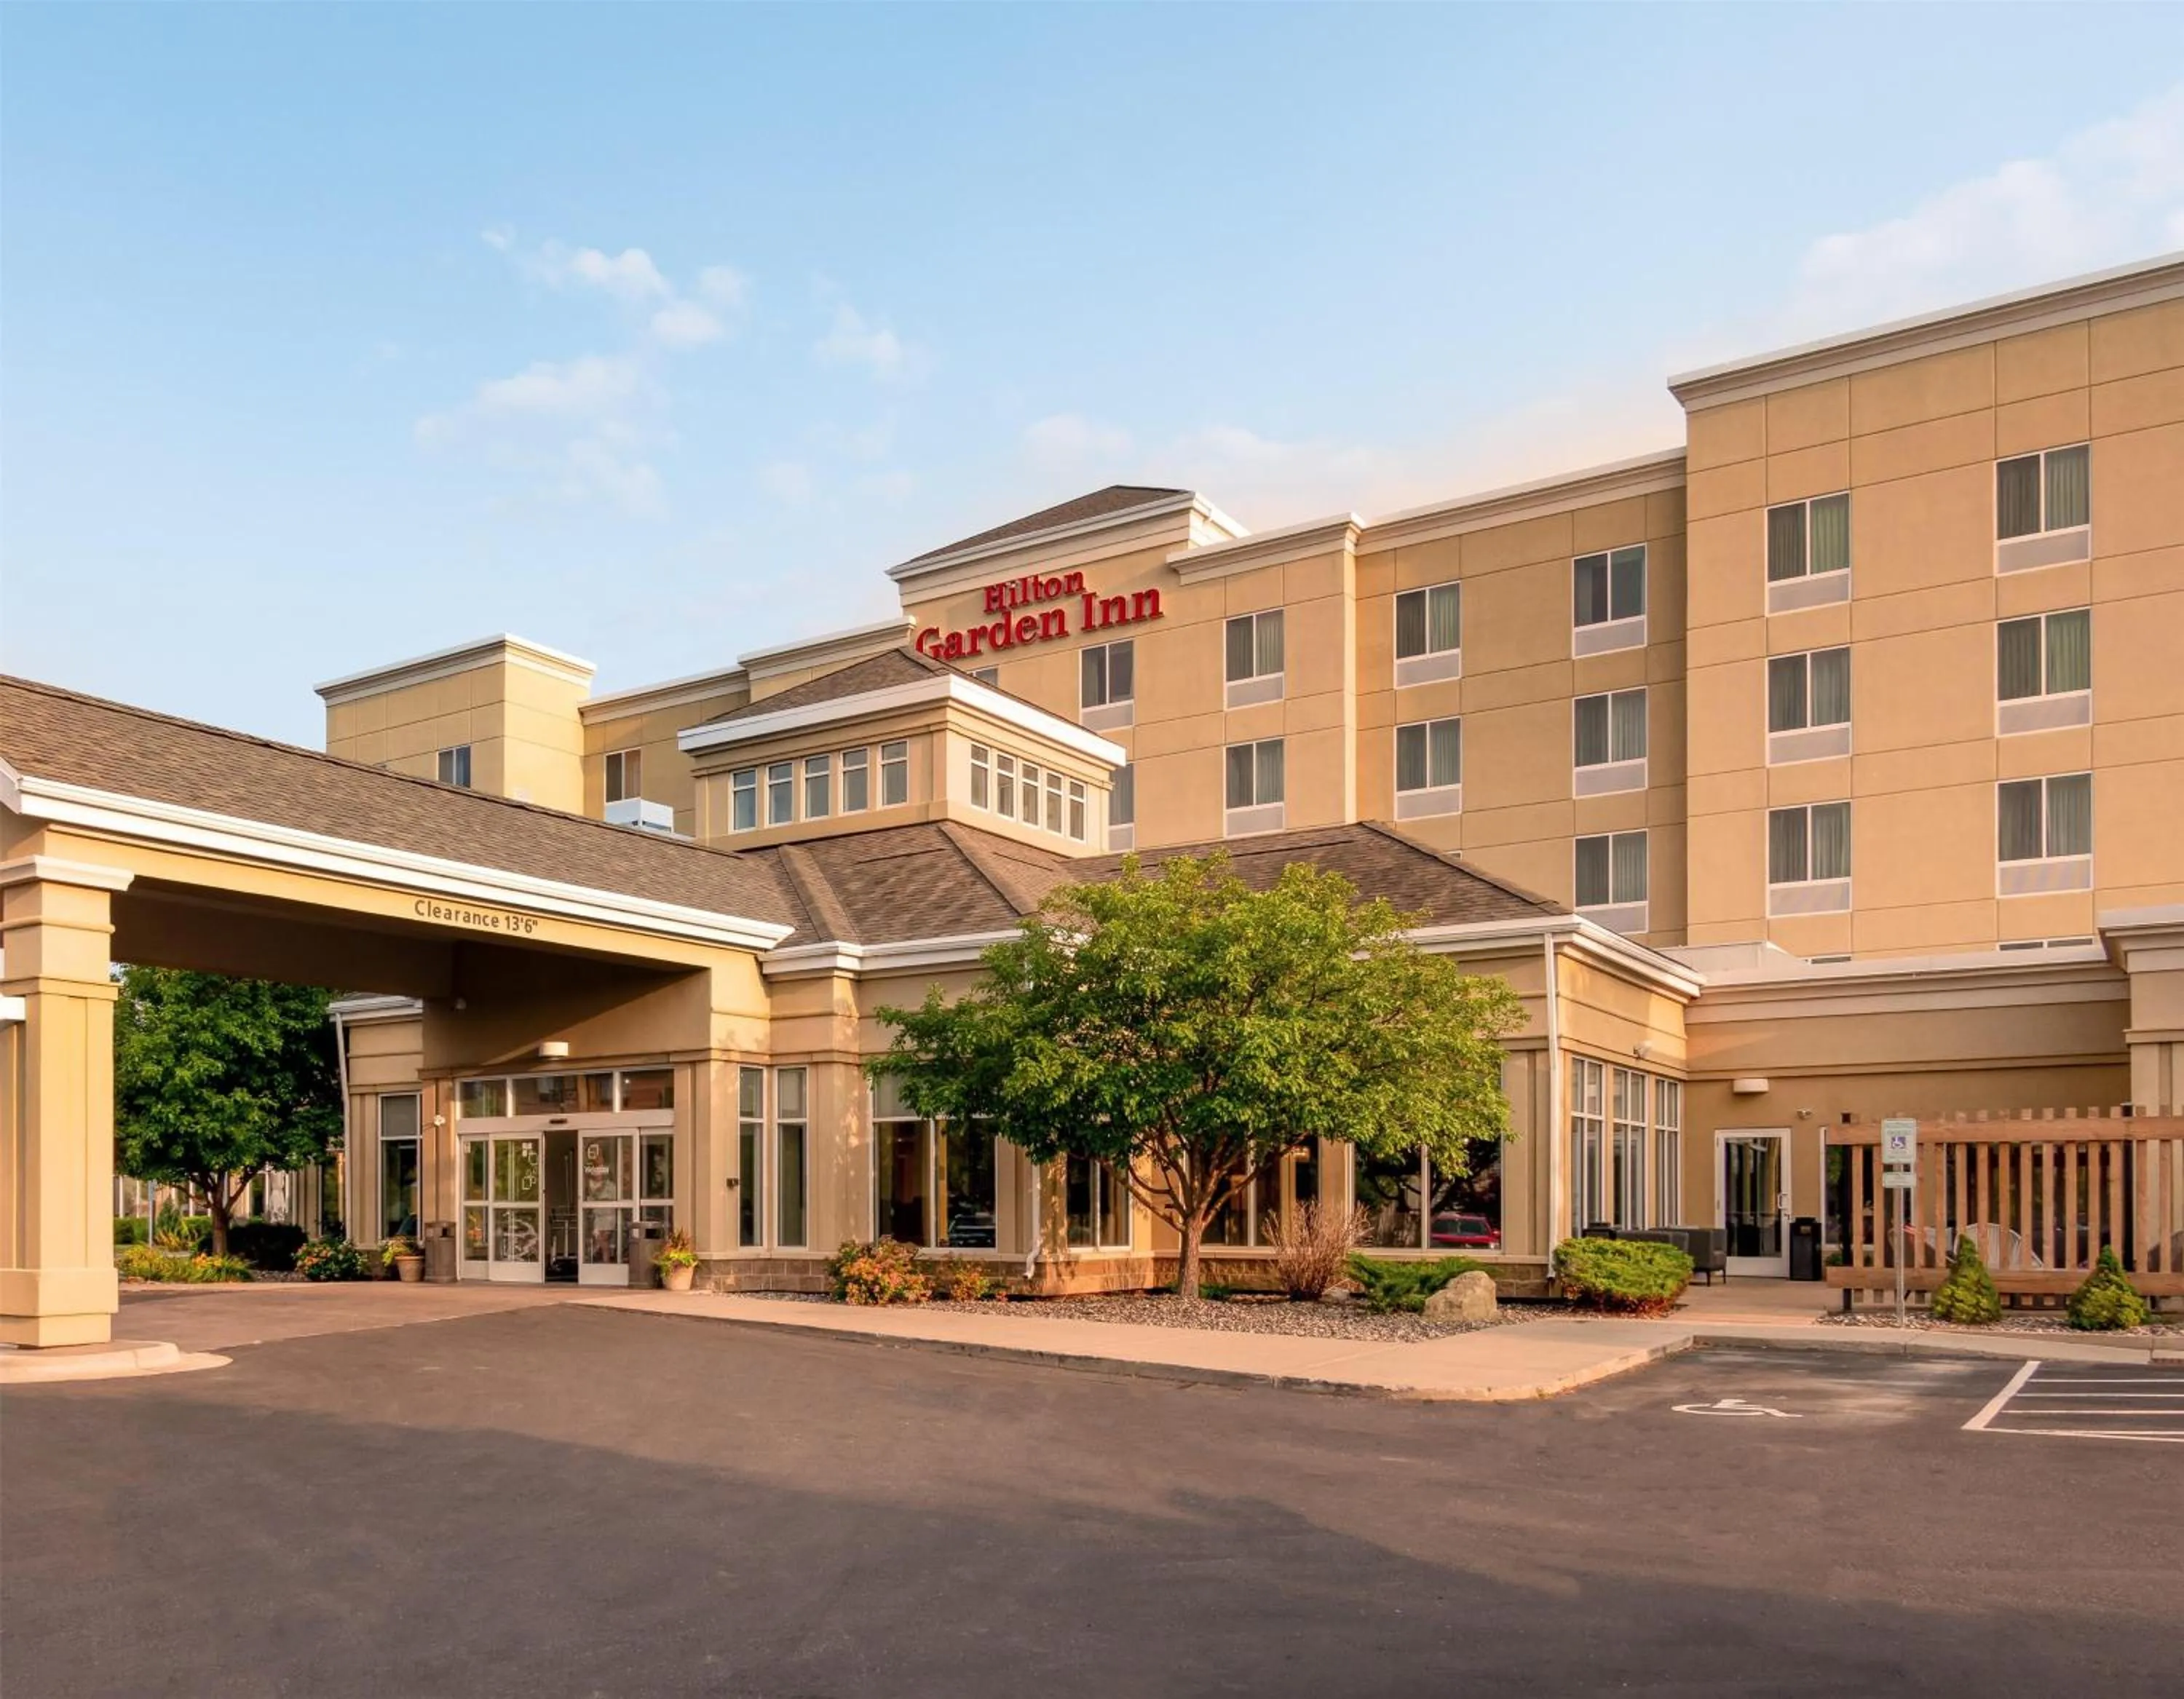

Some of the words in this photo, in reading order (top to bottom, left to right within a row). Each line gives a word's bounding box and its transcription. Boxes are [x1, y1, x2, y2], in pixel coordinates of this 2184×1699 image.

[983, 571, 1086, 614] Hilton
[915, 607, 1069, 660] Garden
[1081, 587, 1164, 633] Inn
[414, 899, 499, 927] Clearance
[505, 914, 538, 933] 13'6"
